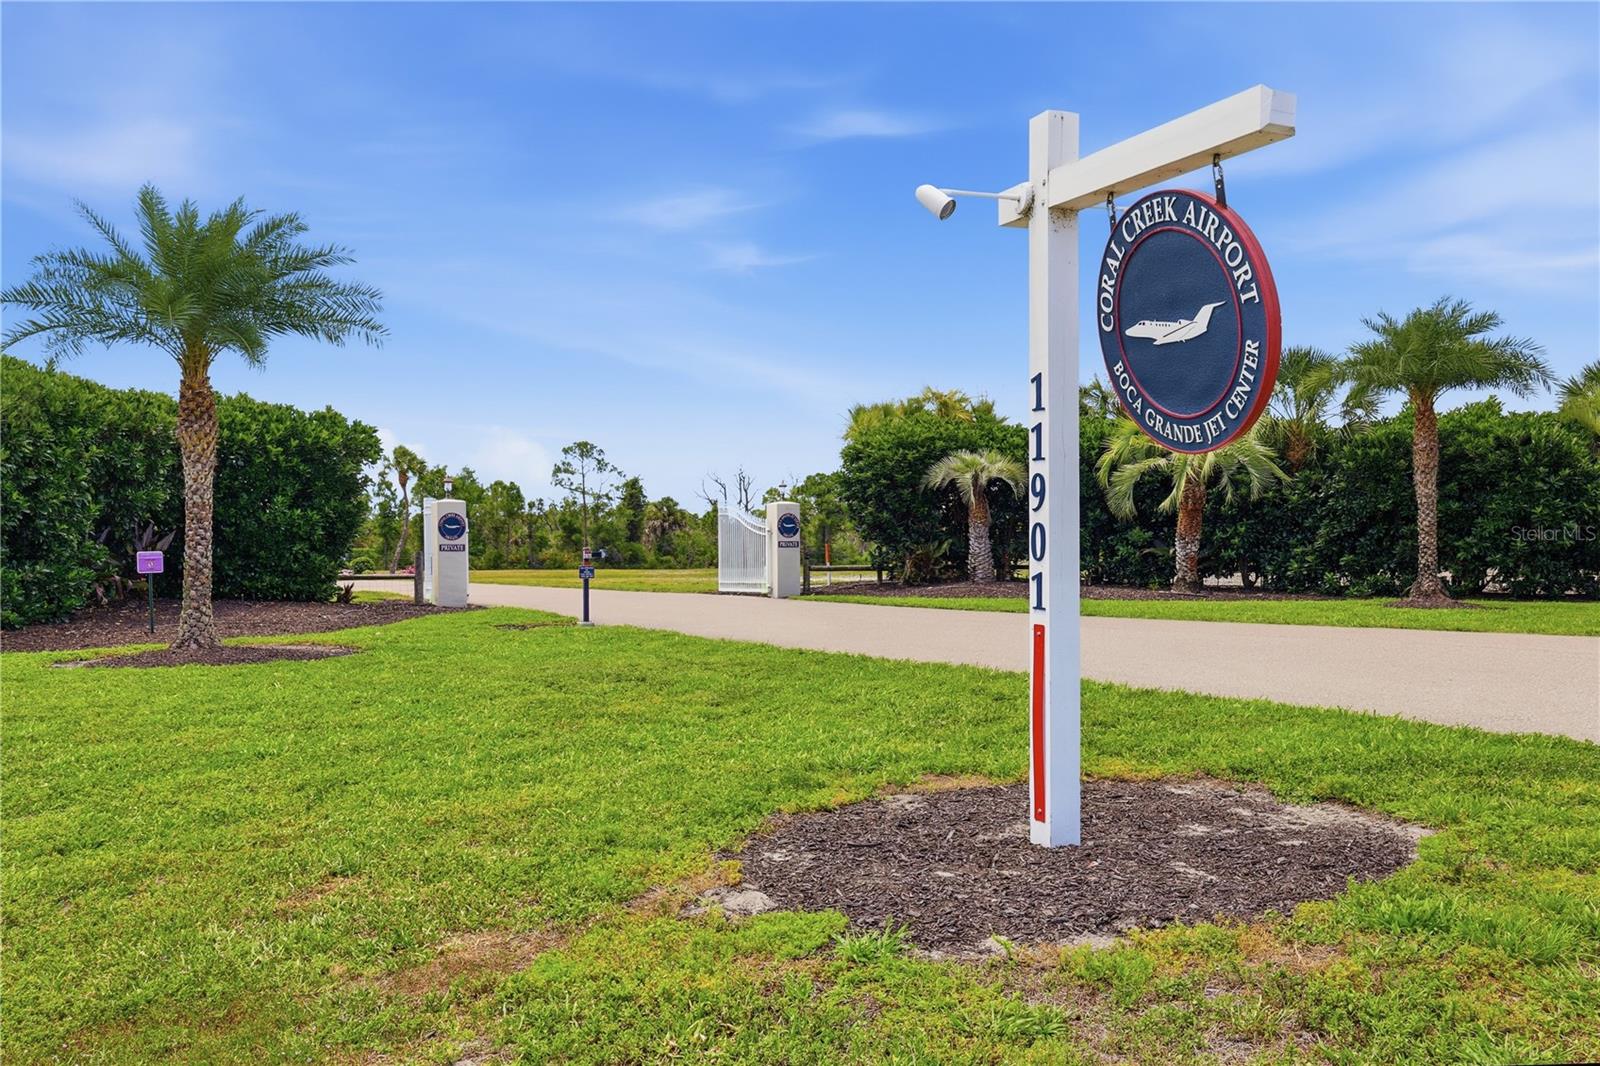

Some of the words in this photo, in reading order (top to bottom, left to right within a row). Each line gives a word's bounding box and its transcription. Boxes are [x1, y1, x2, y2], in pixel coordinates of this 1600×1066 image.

[1100, 244, 1125, 333] CORAL
[1122, 196, 1178, 243] CREEK
[1182, 201, 1260, 305] AIRPORT
[1113, 360, 1143, 413] BOCA
[1144, 408, 1204, 444] GRANDE
[1203, 417, 1227, 445] JET
[1225, 339, 1260, 420] CENTER
[1030, 372, 1046, 611] 11901
